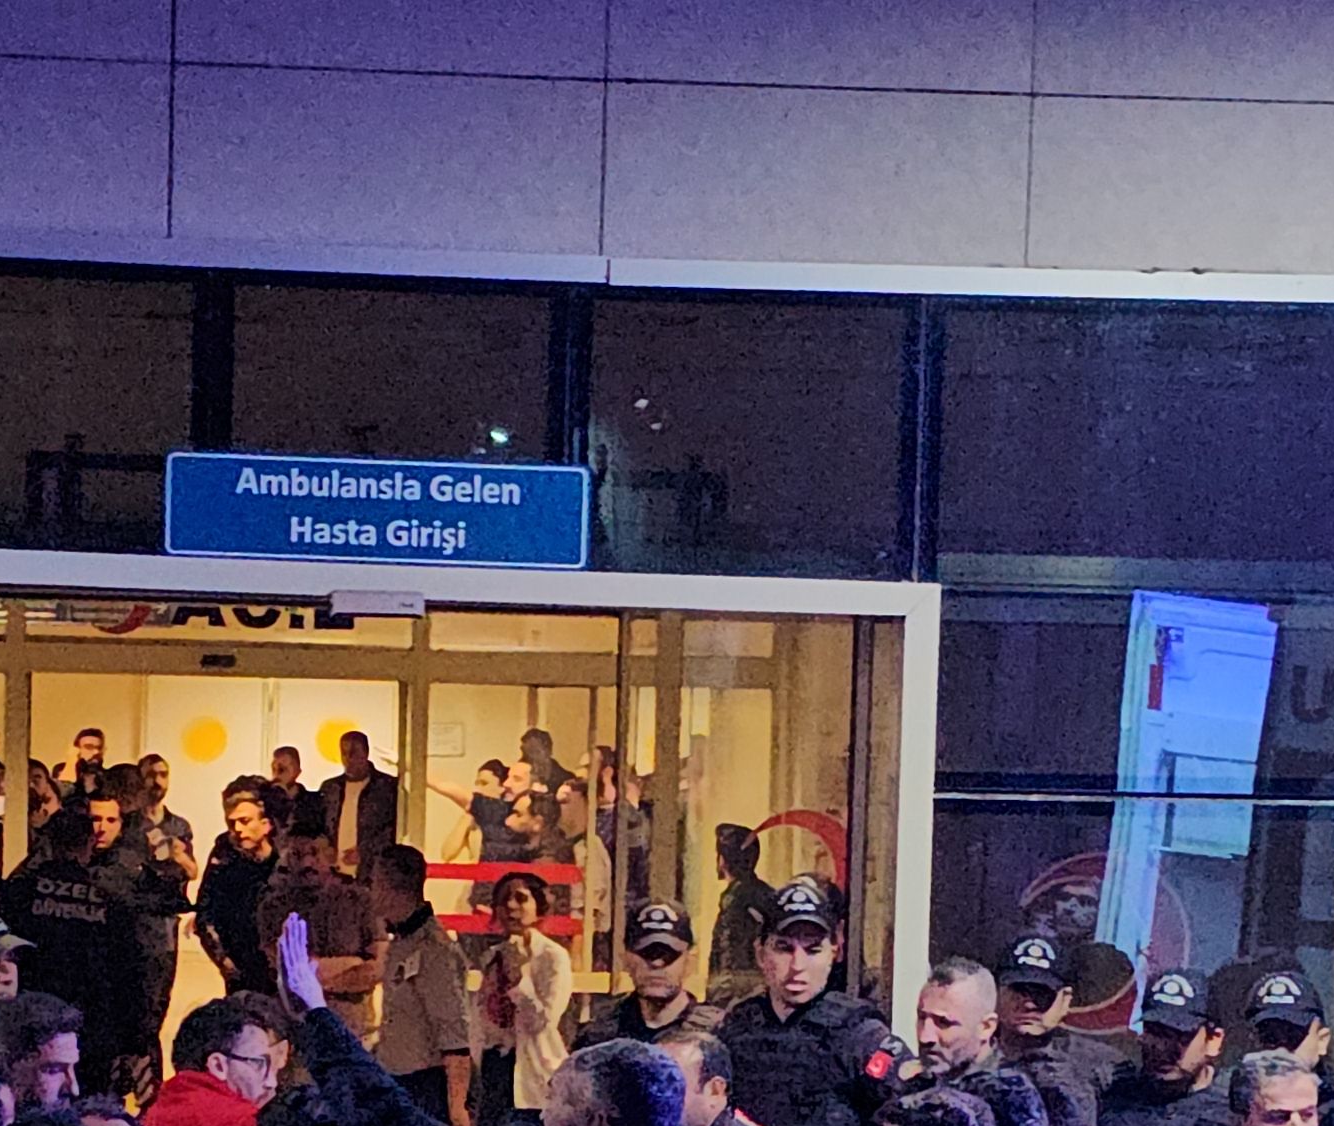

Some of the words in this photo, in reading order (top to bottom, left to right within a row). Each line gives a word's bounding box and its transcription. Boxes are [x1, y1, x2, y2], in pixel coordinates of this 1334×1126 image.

[235, 467, 421, 500] Ambulansla
[429, 475, 521, 505] Gelen
[290, 516, 377, 546] Hasta
[386, 520, 466, 555] Girişi
